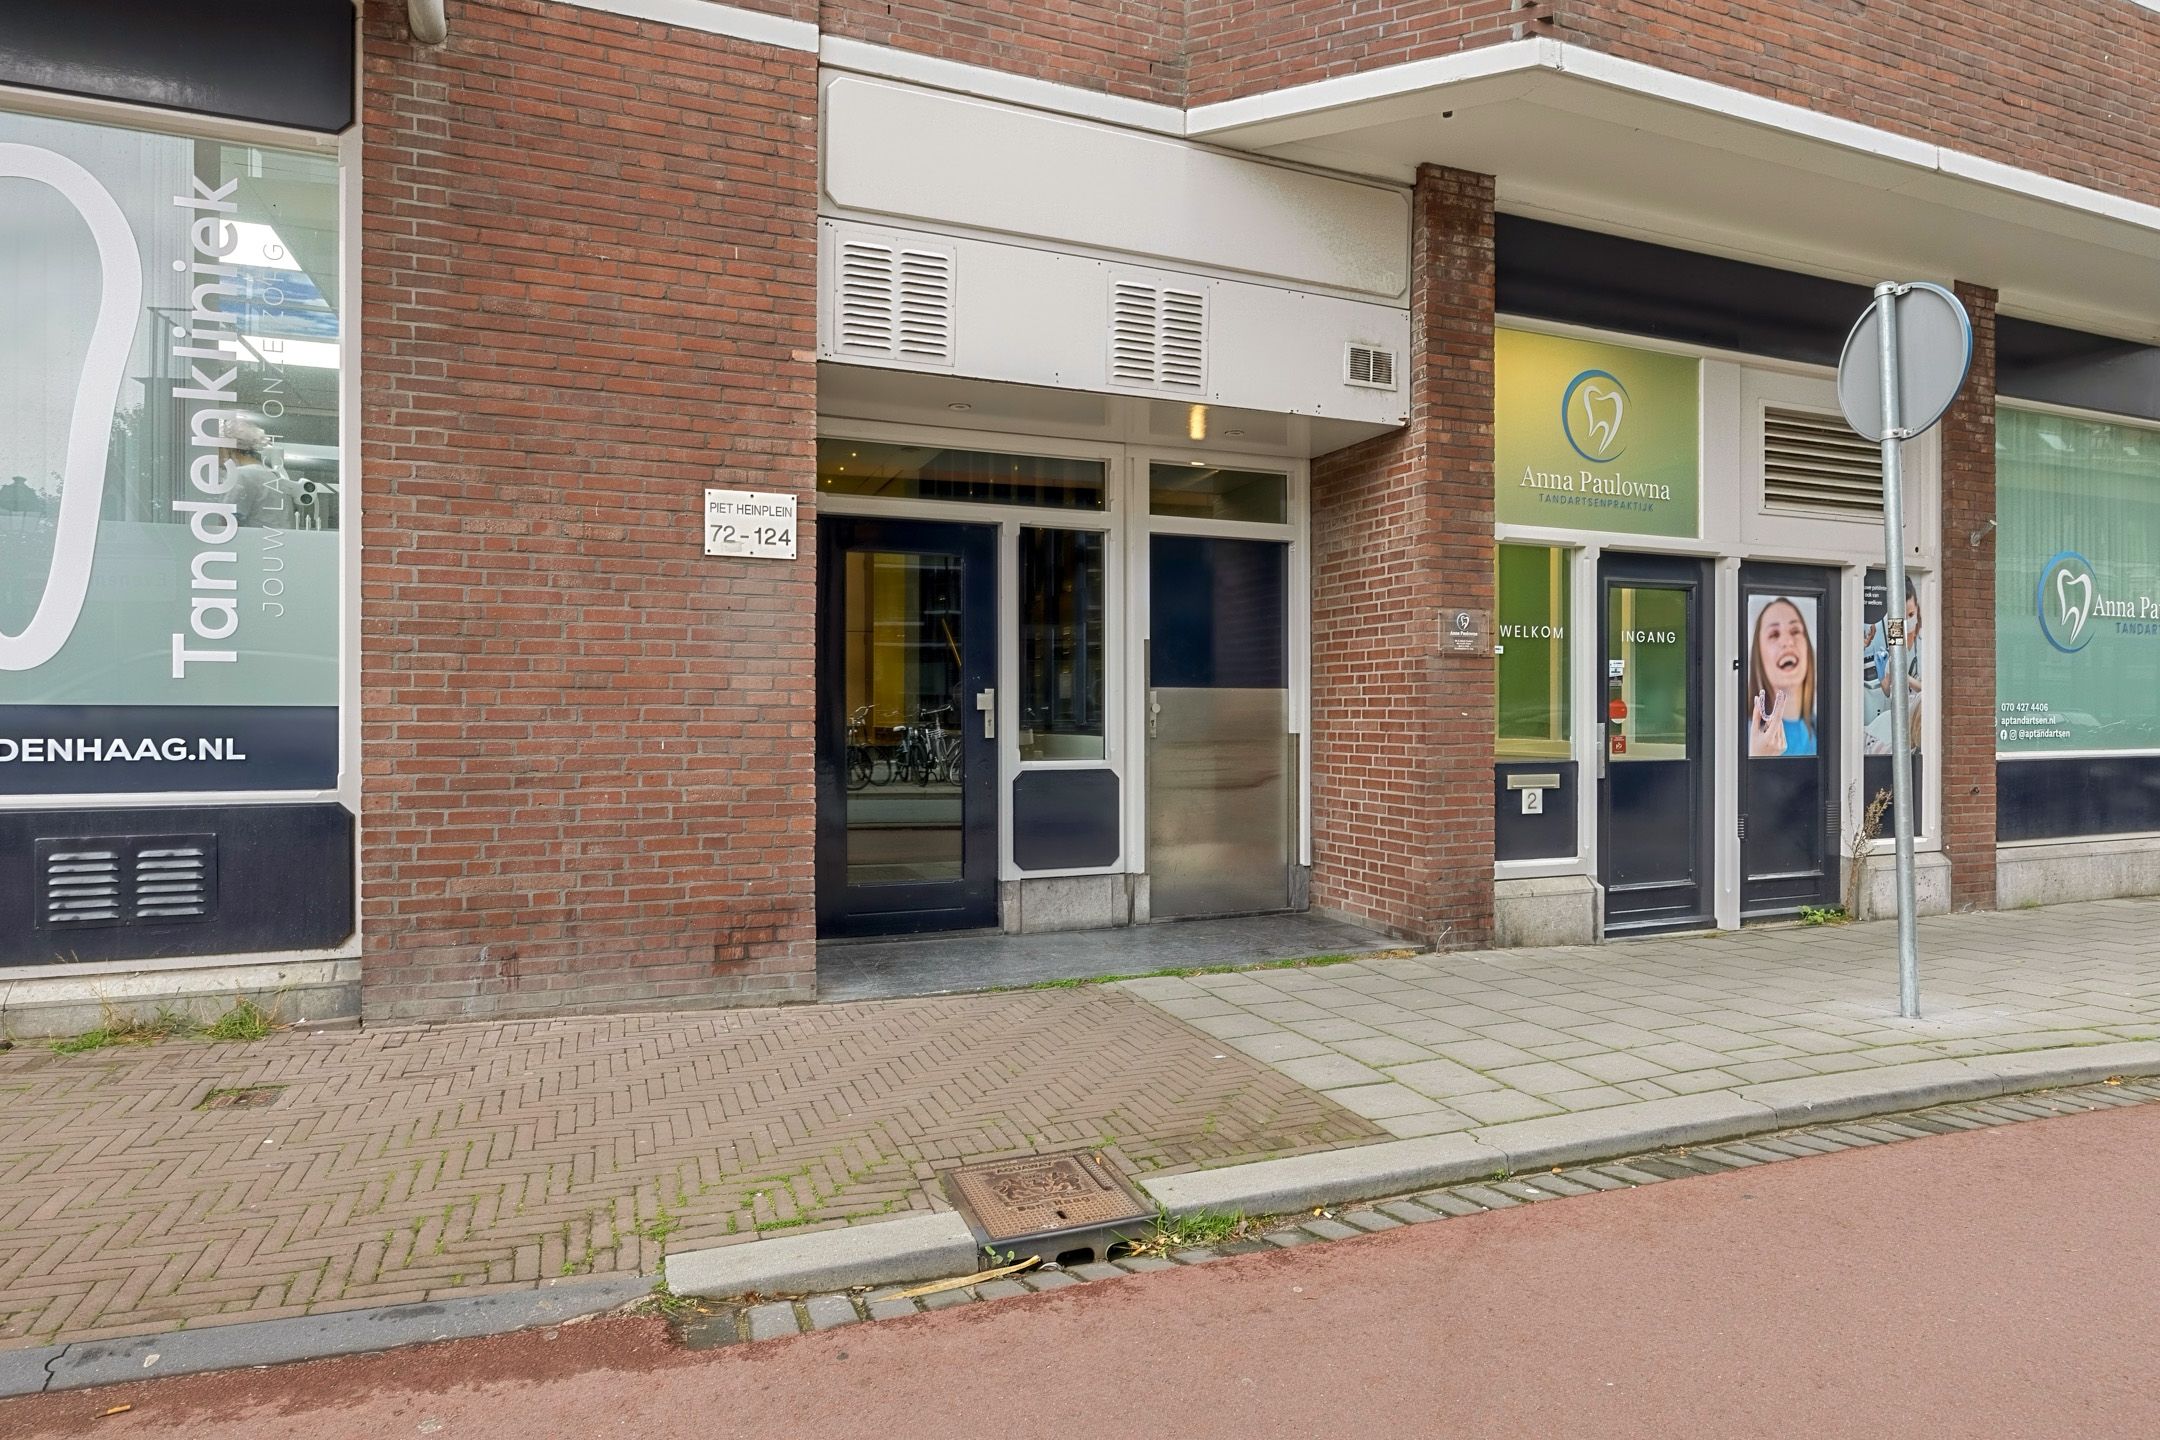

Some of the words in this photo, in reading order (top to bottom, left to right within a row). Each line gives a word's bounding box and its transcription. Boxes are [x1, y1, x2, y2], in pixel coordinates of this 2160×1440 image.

[262, 339, 285, 418] ONZE
[172, 175, 239, 679] Tandenkliniek
[1519, 464, 1574, 491] Anna
[1579, 470, 1671, 500] Paulowna
[709, 501, 734, 514] PIET
[736, 503, 793, 518] HEINPLEIN
[1538, 493, 1655, 512] TANDARTSENPRAKTIJK
[262, 525, 285, 618] JOUW
[2092, 593, 2136, 618] Anna
[2139, 596, 2160, 619] Pa
[1499, 624, 1564, 640] WELKOM
[1621, 630, 1677, 644] INGANG
[2116, 622, 2160, 636] TANDAR
[2001, 702, 2015, 712] 070
[2016, 703, 2030, 712] 427
[2030, 703, 2049, 712] 4406
[2001, 715, 2056, 727] aptandartsen.nl
[2018, 728, 2071, 740] @aptandartsen
[0, 737, 246, 762] DENHAAG.NL
[1527, 792, 1538, 810] 2
